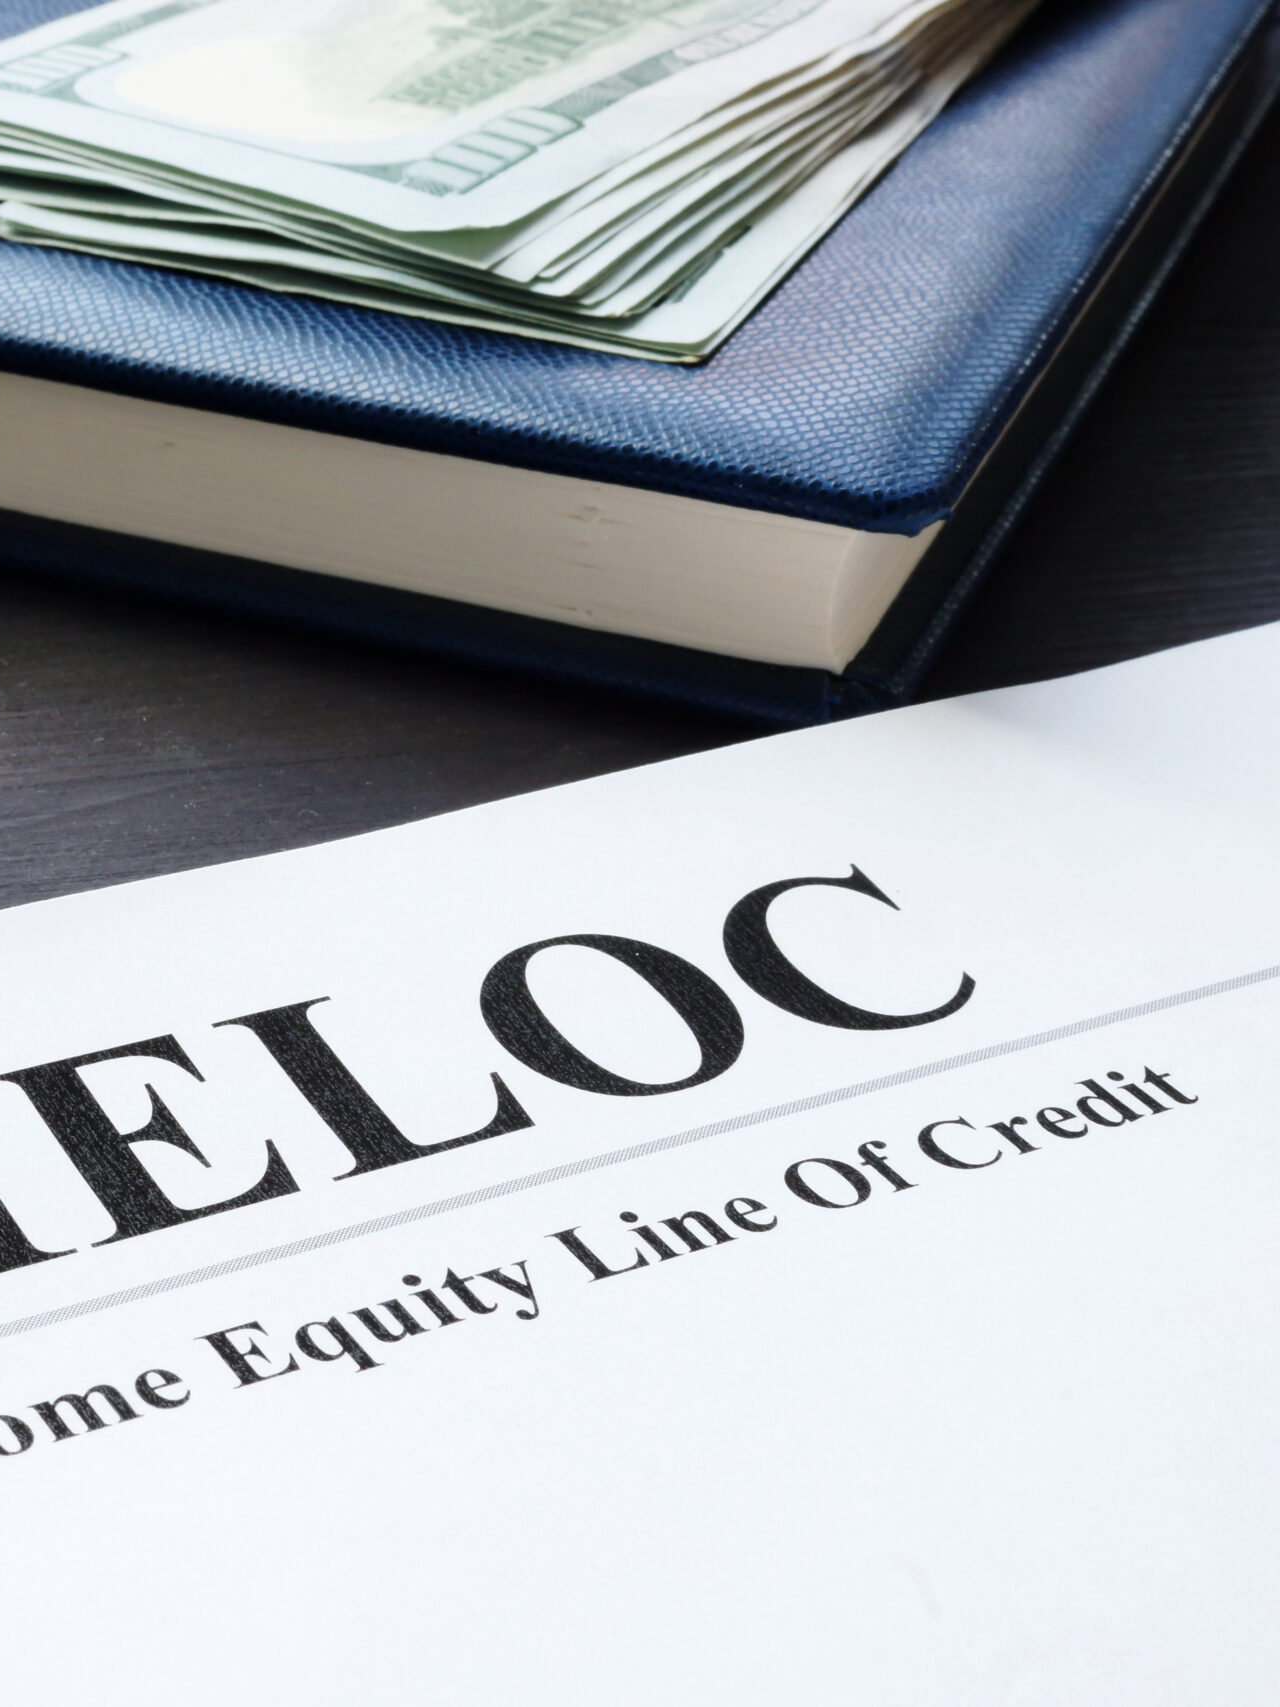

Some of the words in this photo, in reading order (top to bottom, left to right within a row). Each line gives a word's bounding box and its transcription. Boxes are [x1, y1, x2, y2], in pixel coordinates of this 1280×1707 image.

[400, 107, 583, 196] 100
[200, 1260, 540, 1388] Equity
[549, 1197, 778, 1281] Line
[783, 1141, 918, 1209] Of
[917, 1066, 1199, 1170] Credit
